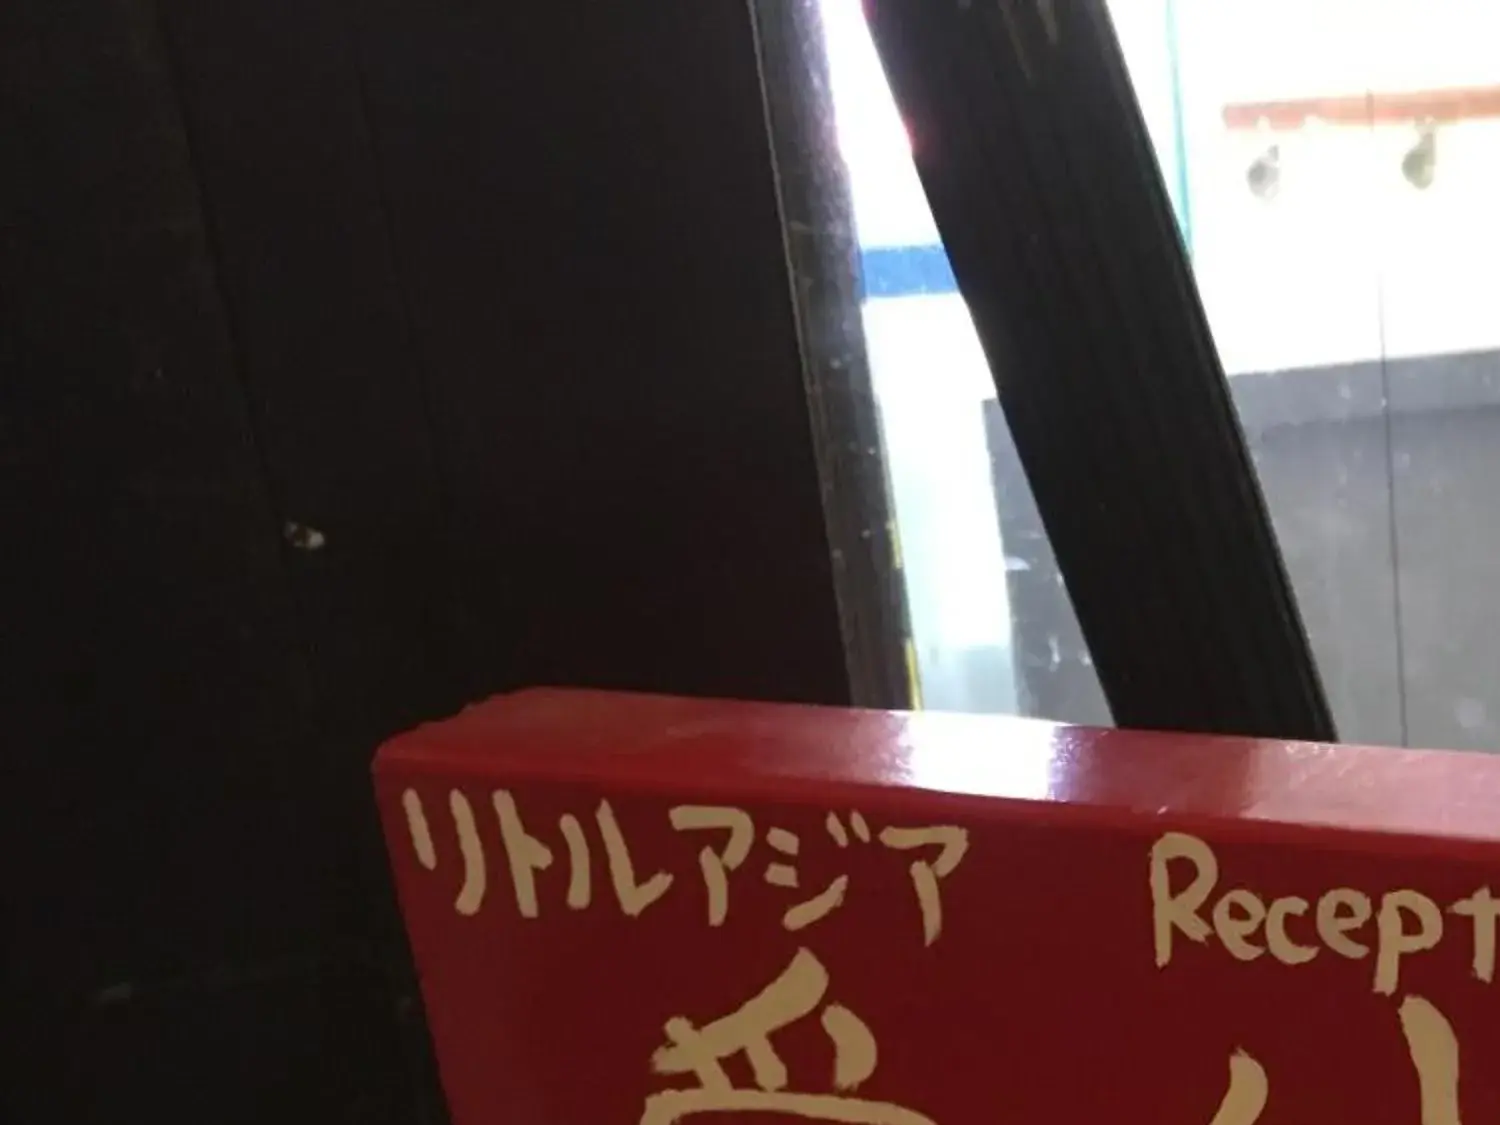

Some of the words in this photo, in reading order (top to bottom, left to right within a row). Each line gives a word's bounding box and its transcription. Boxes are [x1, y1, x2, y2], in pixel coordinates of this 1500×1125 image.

[404, 787, 968, 945] リトルアジア
